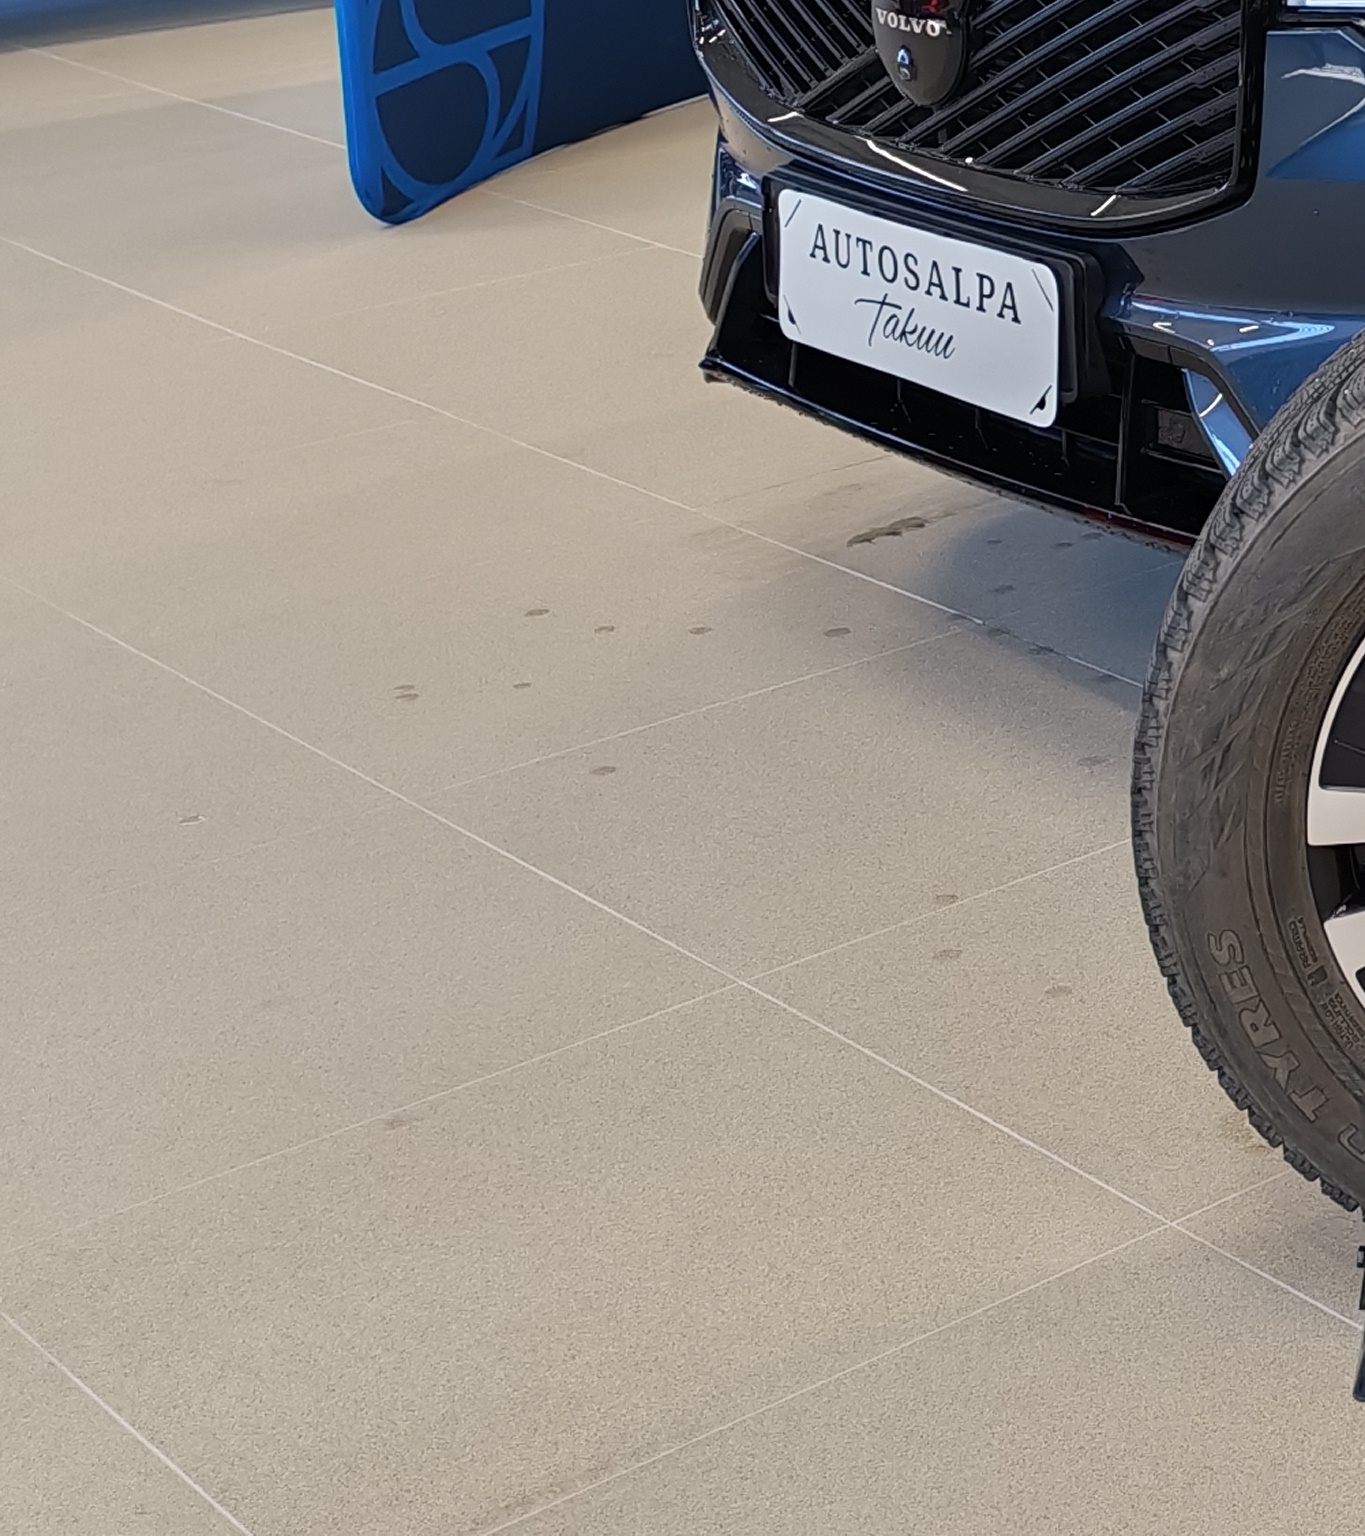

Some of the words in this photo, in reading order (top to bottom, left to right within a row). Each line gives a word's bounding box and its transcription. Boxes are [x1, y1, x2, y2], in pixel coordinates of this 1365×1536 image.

[875, 7, 941, 37] VOLVO
[809, 223, 1021, 325] AUTOSALPA
[854, 293, 956, 360] Takuu
[1207, 928, 1329, 1123] TYRES
